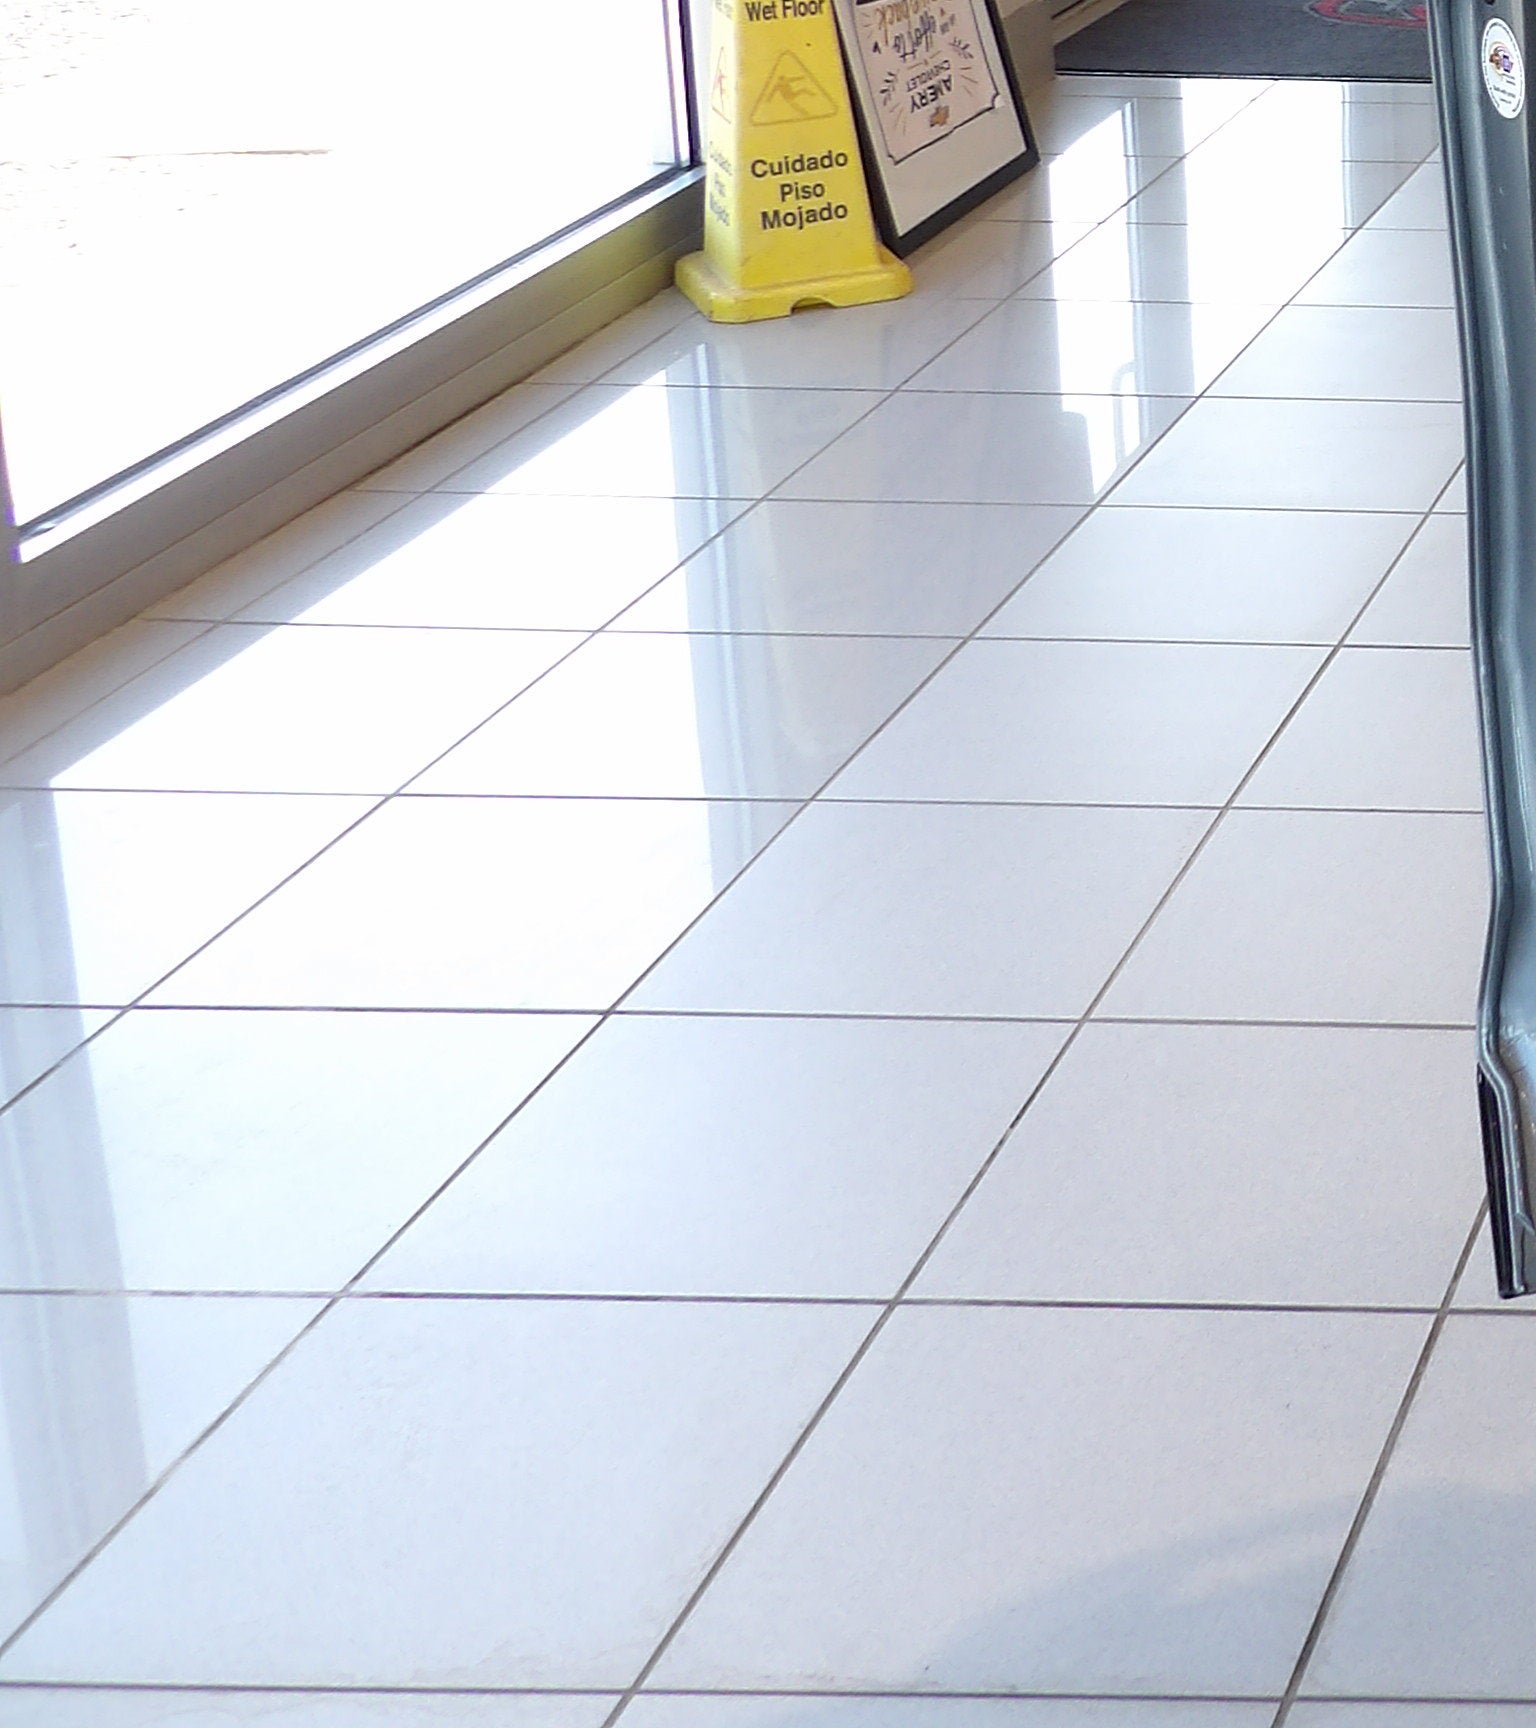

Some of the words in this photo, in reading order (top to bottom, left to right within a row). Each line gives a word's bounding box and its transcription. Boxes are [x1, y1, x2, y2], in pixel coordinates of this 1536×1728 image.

[745, 1, 778, 21] Wet
[751, 150, 848, 178] Cuidado
[780, 182, 825, 202] Piso
[761, 202, 848, 230] Mojado
